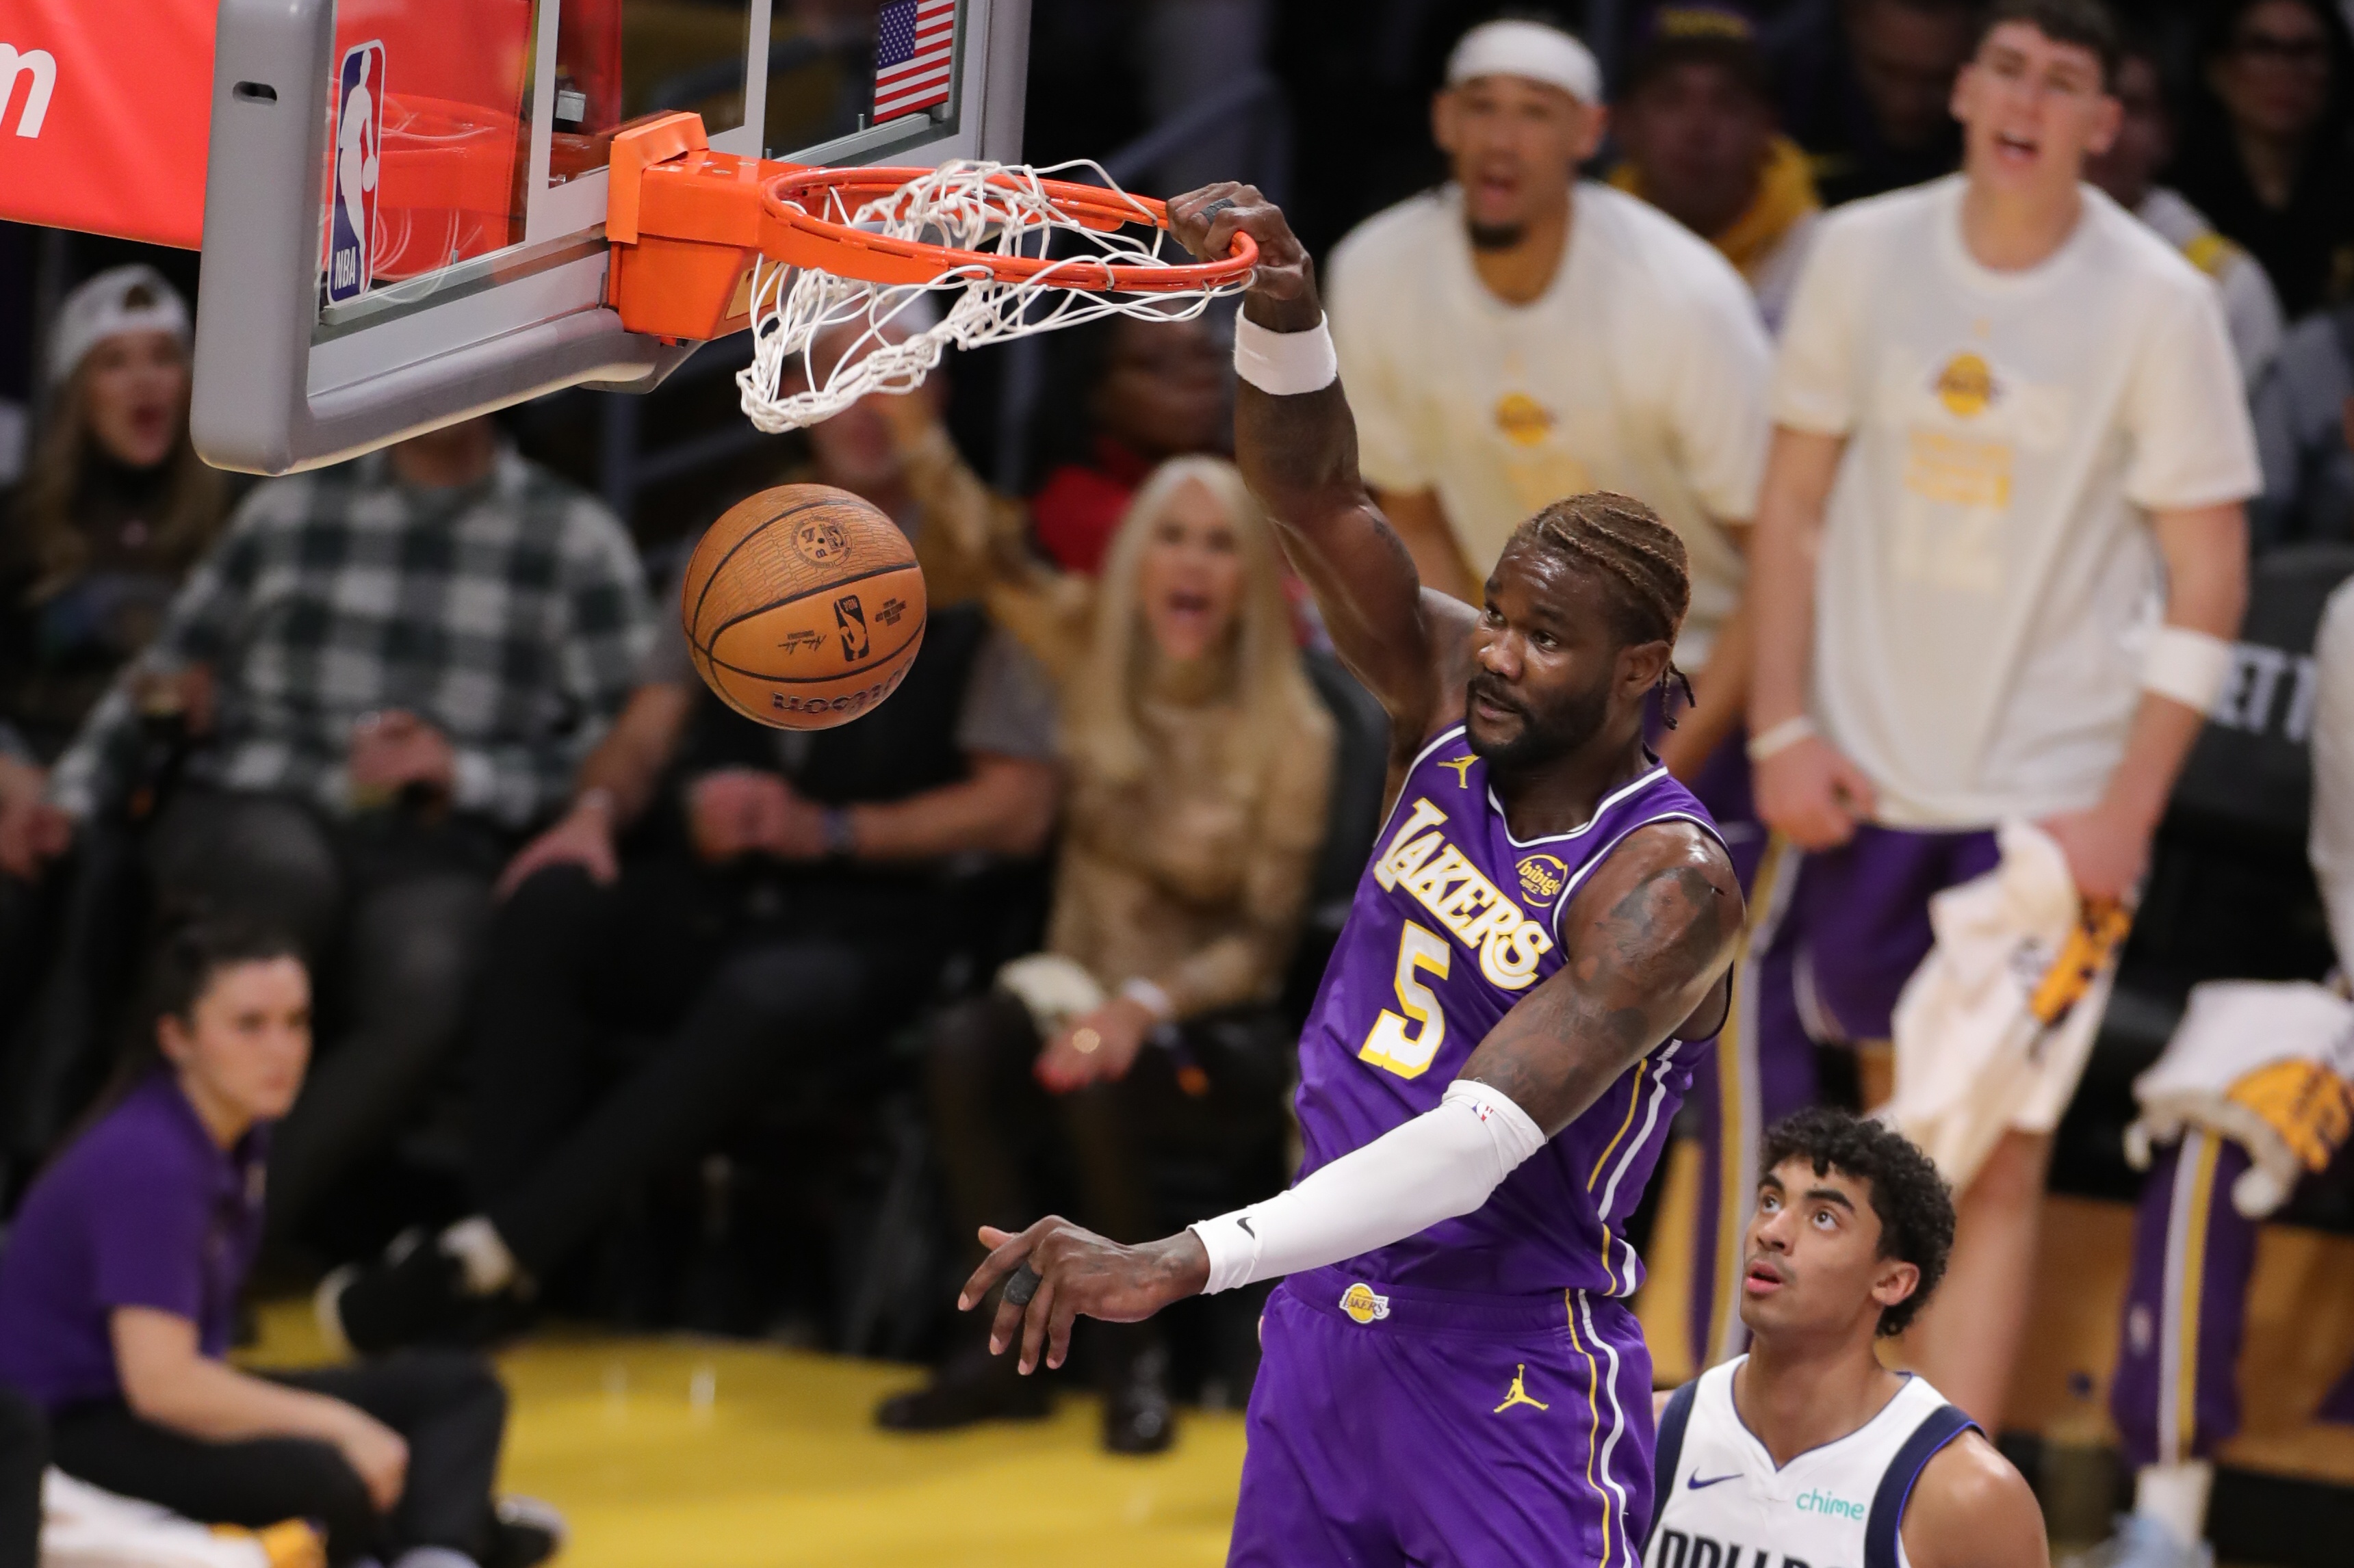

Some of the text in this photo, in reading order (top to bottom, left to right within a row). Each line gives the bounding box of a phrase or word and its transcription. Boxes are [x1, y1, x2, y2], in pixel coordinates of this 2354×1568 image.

[334, 246, 356, 290] NBA
[1373, 797, 1554, 990] LAKERS
[1518, 861, 1561, 896] bibigo
[1358, 919, 1451, 1080] 5
[1343, 1290, 1386, 1318] LAKERS
[1796, 1488, 1865, 1521] chime
